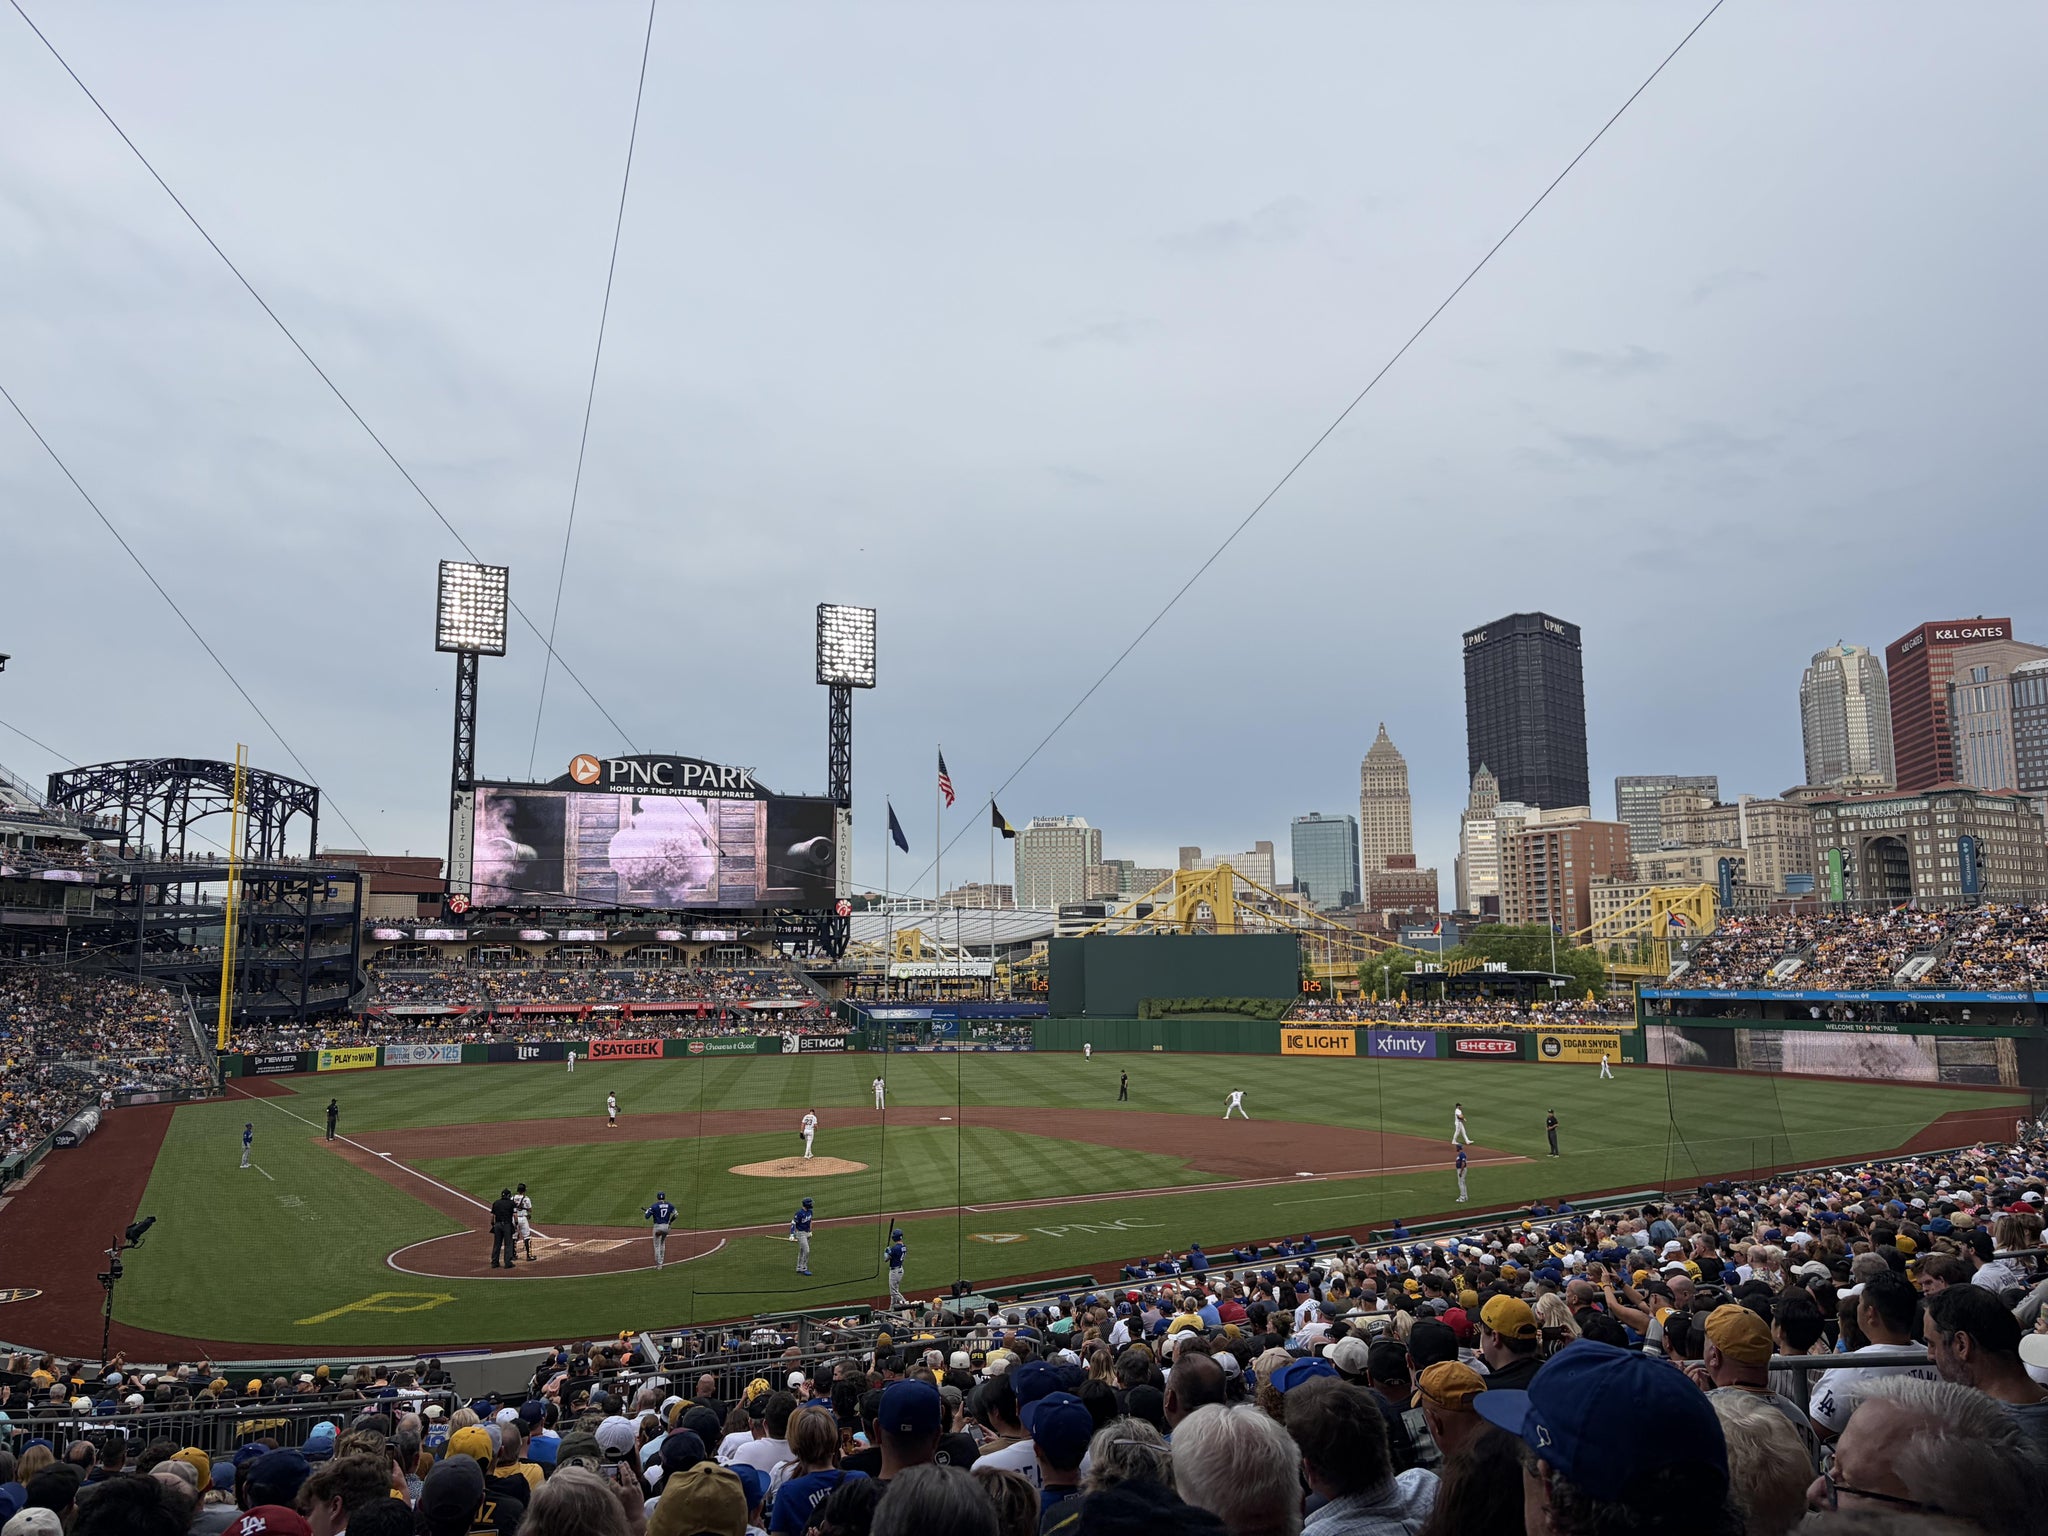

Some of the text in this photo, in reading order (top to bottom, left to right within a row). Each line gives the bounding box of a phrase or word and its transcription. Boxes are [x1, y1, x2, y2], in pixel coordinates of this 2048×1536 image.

[1544, 619, 1565, 635] UPMC
[1935, 627, 2004, 640] K&L GATES
[606, 759, 756, 790] PNC PARK
[609, 785, 755, 799] HOME OF THE PITTSBURGH PIRATES
[458, 845, 465, 859] GO
[912, 968, 932, 977] FAT
[1424, 955, 1508, 977] IT'S Miller TIME
[1031, 981, 1049, 991] 0:25
[1303, 980, 1321, 992] 0:25
[1825, 1023, 1854, 1031] WELCOME
[737, 1041, 756, 1050] Good
[801, 1038, 844, 1049] BETMGM
[1287, 1035, 1349, 1049] IC LIGHT
[1377, 1034, 1427, 1054] xfinity
[1460, 1042, 1513, 1051] SHEETZ
[1563, 1039, 1618, 1049] EDGAR SNYDER
[441, 1046, 459, 1059] 125
[518, 1046, 540, 1060] Lite
[592, 1042, 659, 1056] SEATGEEK
[334, 1053, 352, 1064] PLAY
[358, 1053, 375, 1062] WIN!
[804, 1118, 813, 1126] 23
[660, 1208, 668, 1218] 17
[1028, 1217, 1166, 1238] PNC
[1818, 1389, 1836, 1418] LA
[240, 1515, 268, 1536] LA
